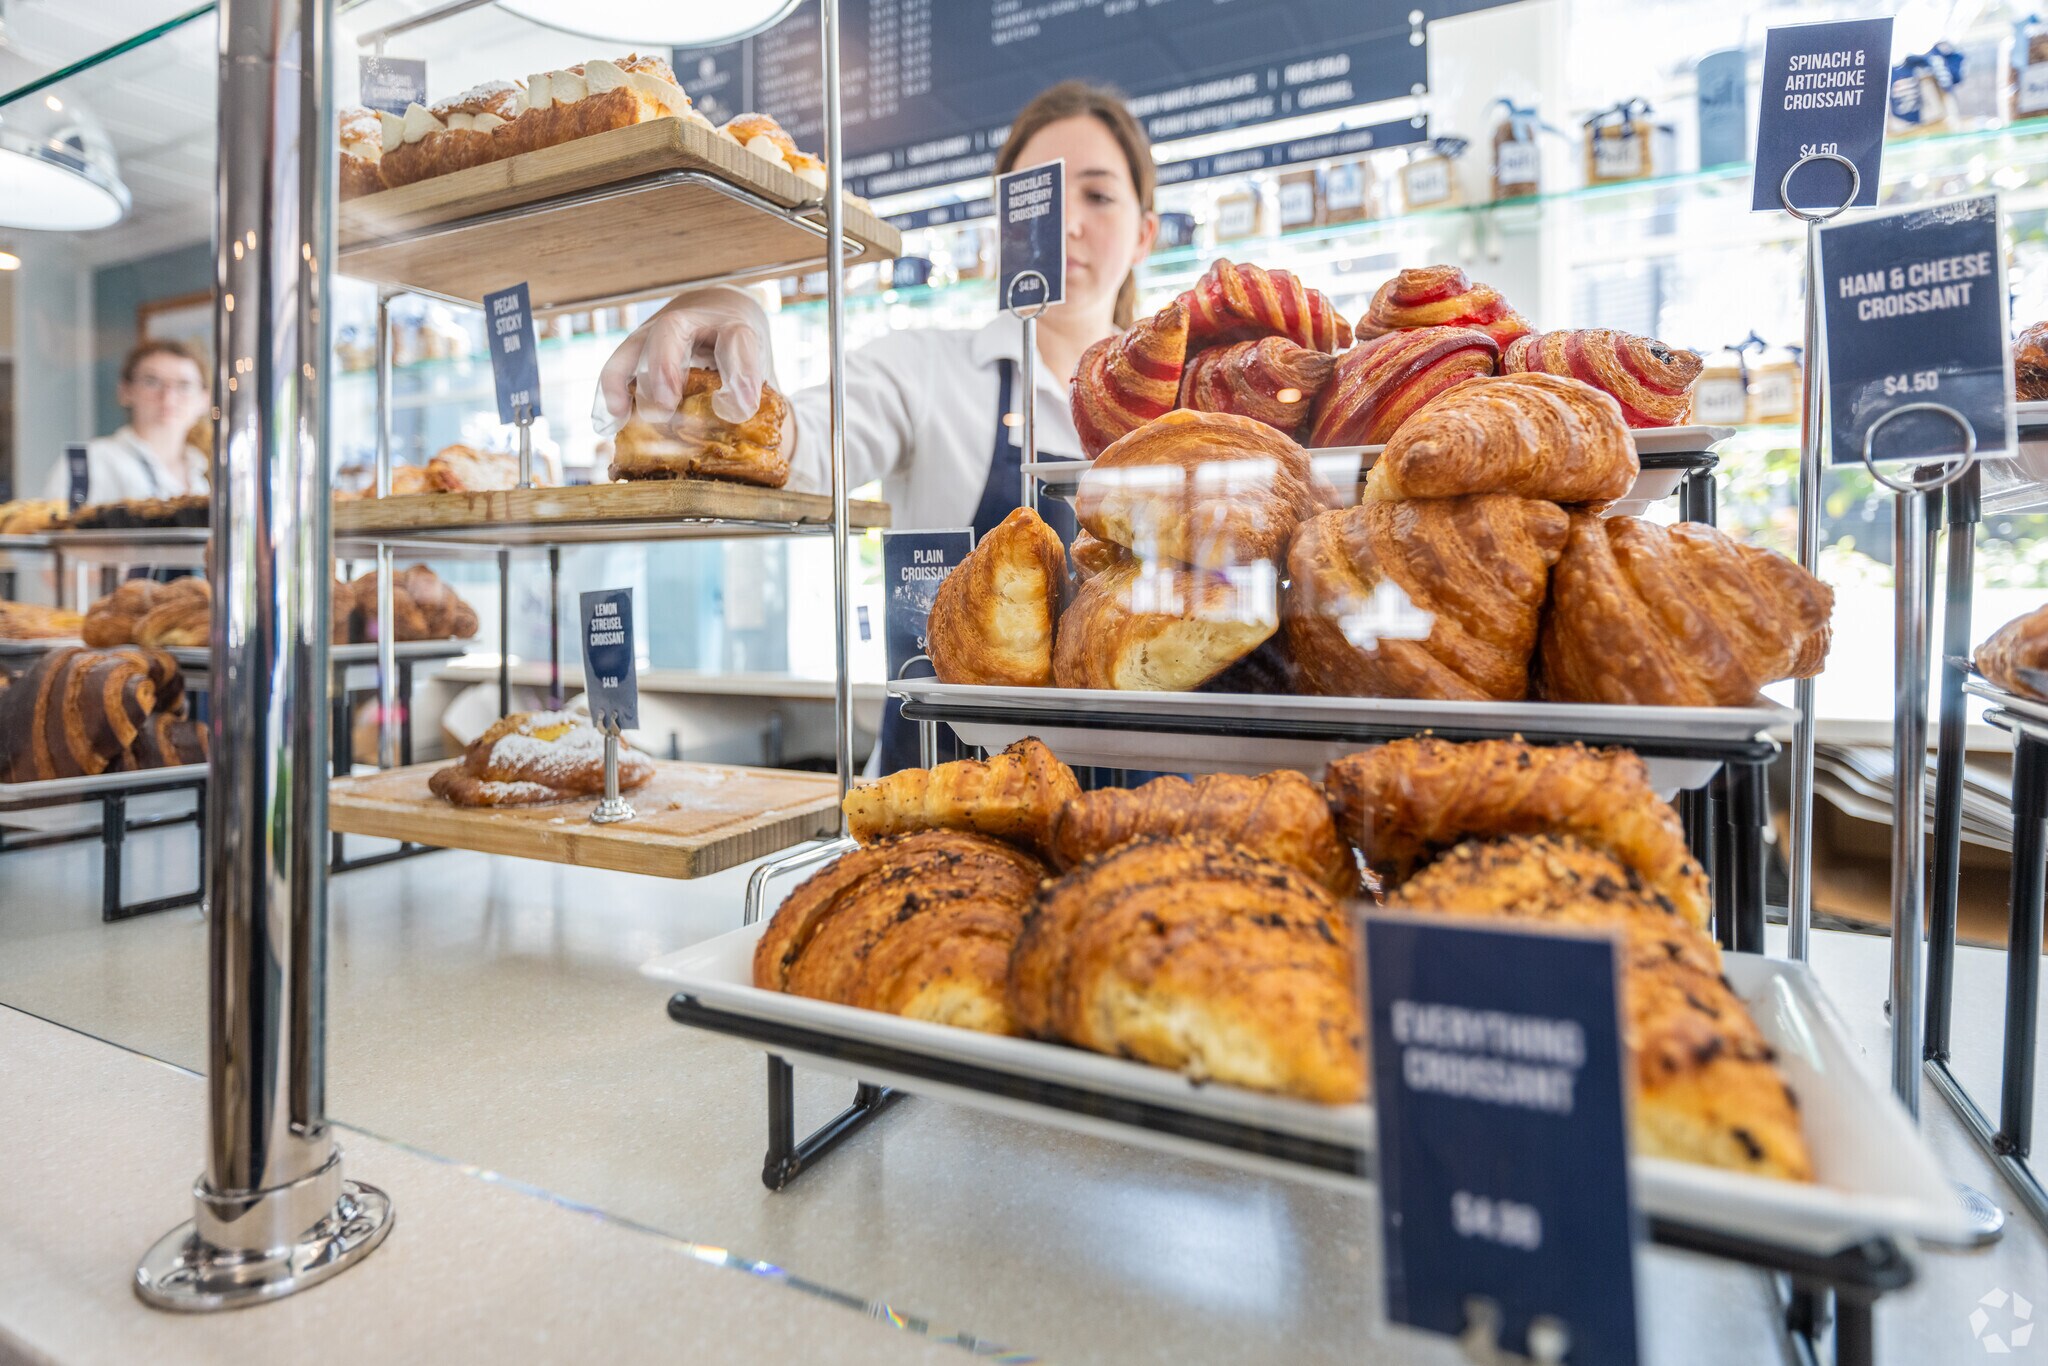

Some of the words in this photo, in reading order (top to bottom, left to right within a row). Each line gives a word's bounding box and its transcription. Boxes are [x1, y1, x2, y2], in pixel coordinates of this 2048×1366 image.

[1788, 51, 1852, 72] SPINACH
[1855, 49, 1866, 66] &
[1784, 69, 1865, 92] ARTICHOKE
[1783, 89, 1864, 111] CROISSANT
[1799, 142, 1838, 158] $450
[1008, 172, 1053, 195] CHOCOLATE
[1008, 187, 1053, 210] RASPBERRY
[1008, 202, 1051, 224] CROISSANT
[1839, 269, 1886, 299] HAM
[1890, 266, 1905, 290] &
[1908, 252, 1991, 287] CHEESE
[493, 293, 519, 316] PECAN
[1857, 283, 1972, 322] CROISSANT
[495, 312, 523, 336] STICKY
[503, 334, 521, 354] BUN
[1883, 371, 1938, 396] $4.50
[913, 549, 944, 564] PLAIN
[594, 602, 618, 617] LEMON
[591, 616, 623, 631] STREUSEL
[590, 631, 625, 646] CROISSANT
[1391, 999, 1585, 1068] EVERYTHING
[1403, 1047, 1574, 1116] CROISSANT
